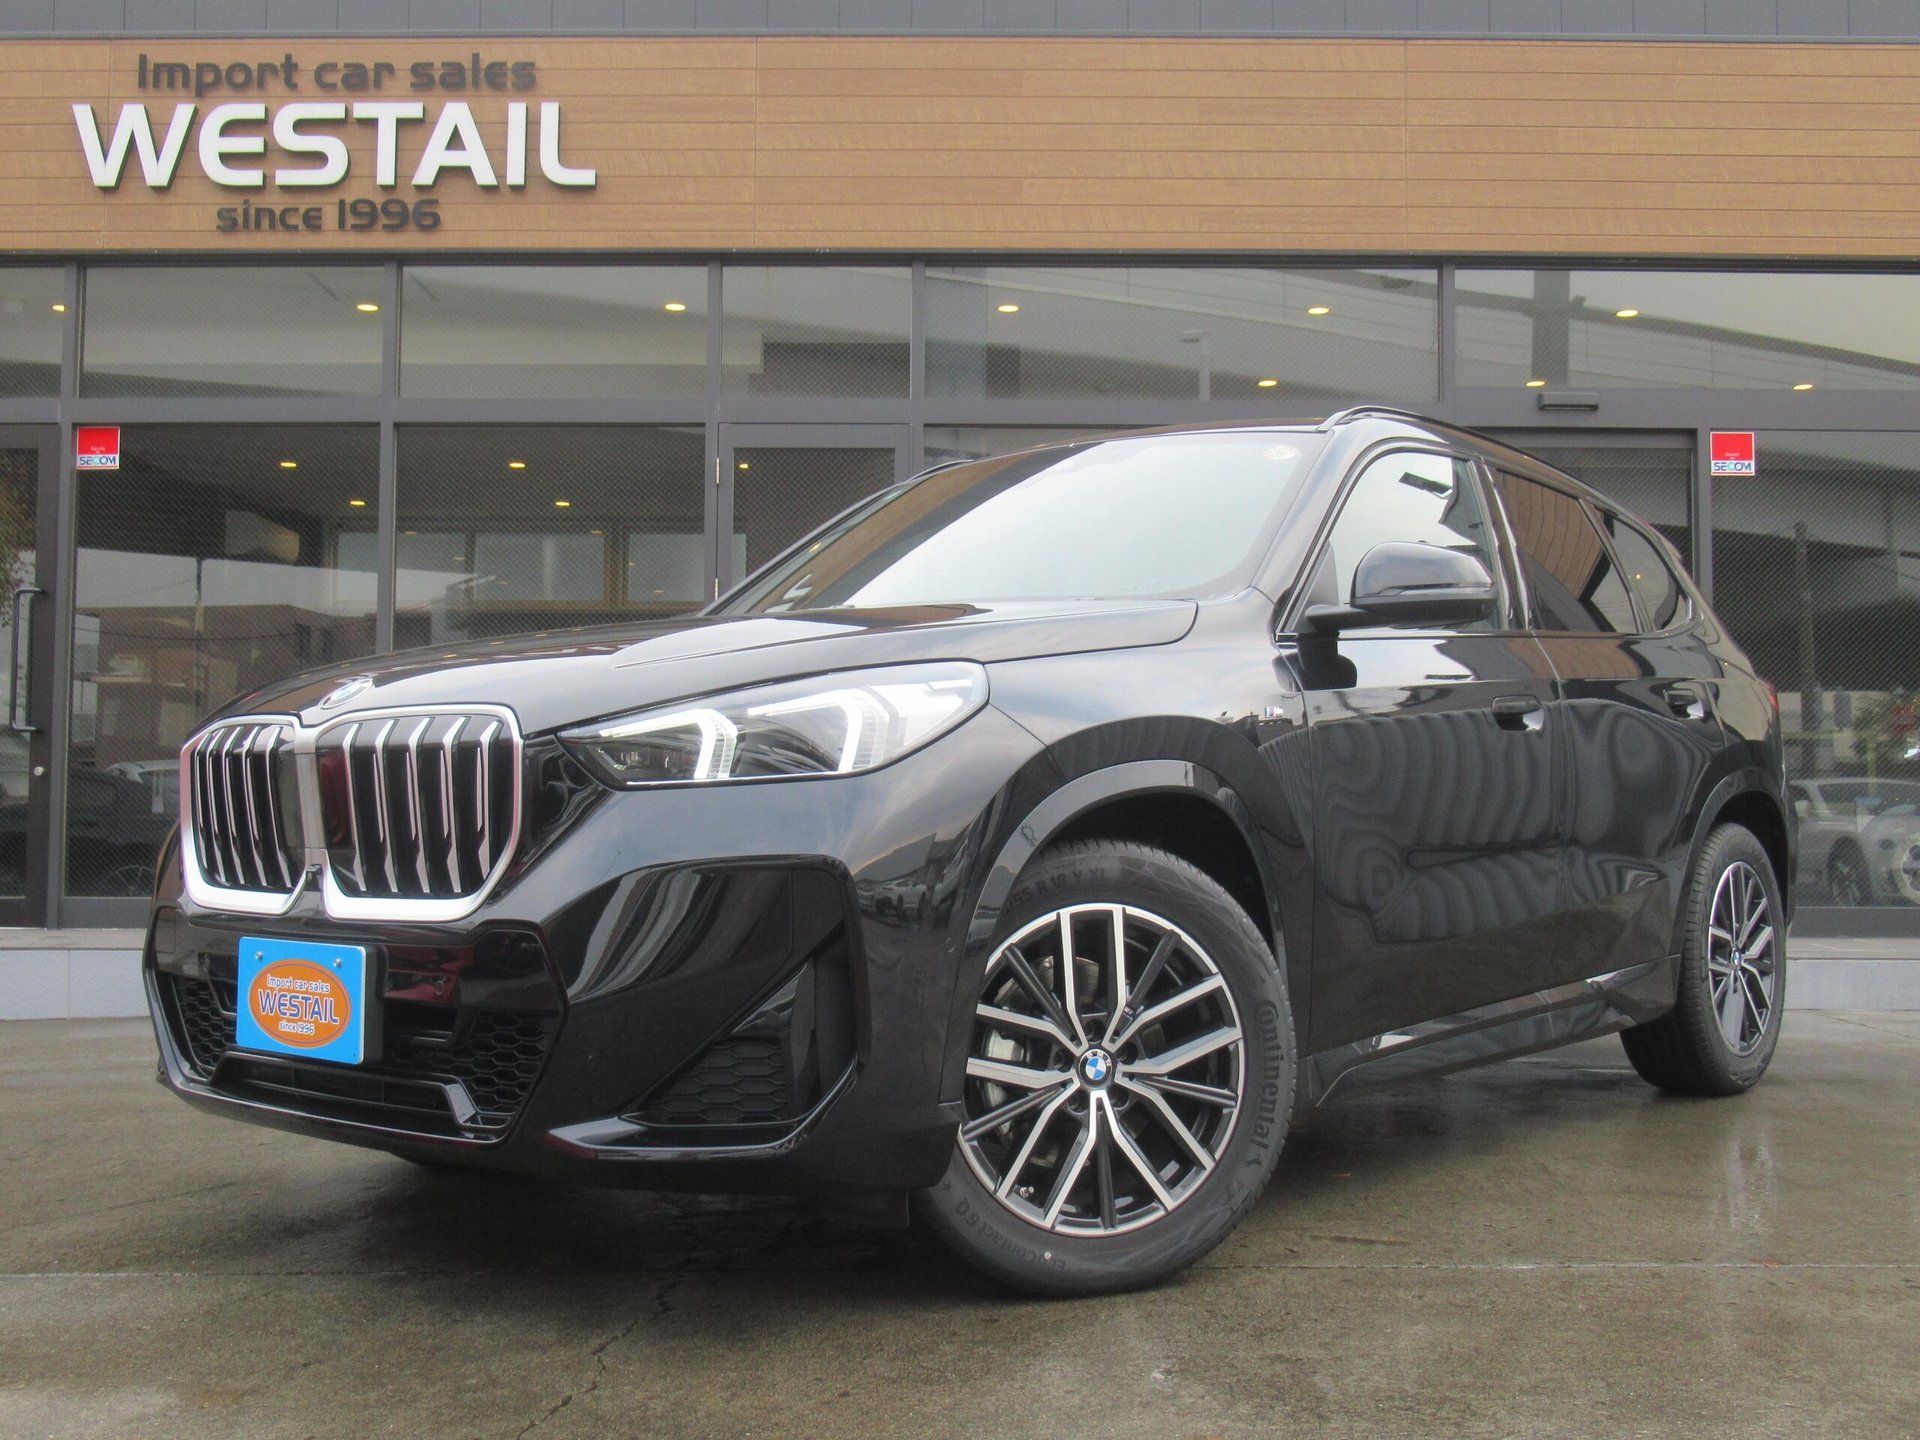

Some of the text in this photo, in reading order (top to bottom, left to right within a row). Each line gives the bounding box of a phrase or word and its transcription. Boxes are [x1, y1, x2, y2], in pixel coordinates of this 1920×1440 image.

[138, 52, 537, 98] Import car sales
[72, 102, 597, 188] WESTAIL
[216, 198, 441, 231] since 1996
[79, 455, 116, 466] SECOM
[1713, 461, 1752, 472] SECOM
[267, 974, 331, 994] Import car sales
[258, 988, 339, 1024] WESTAIL
[279, 1020, 316, 1035] since 1996
[1249, 1000, 1285, 1150] Continental
